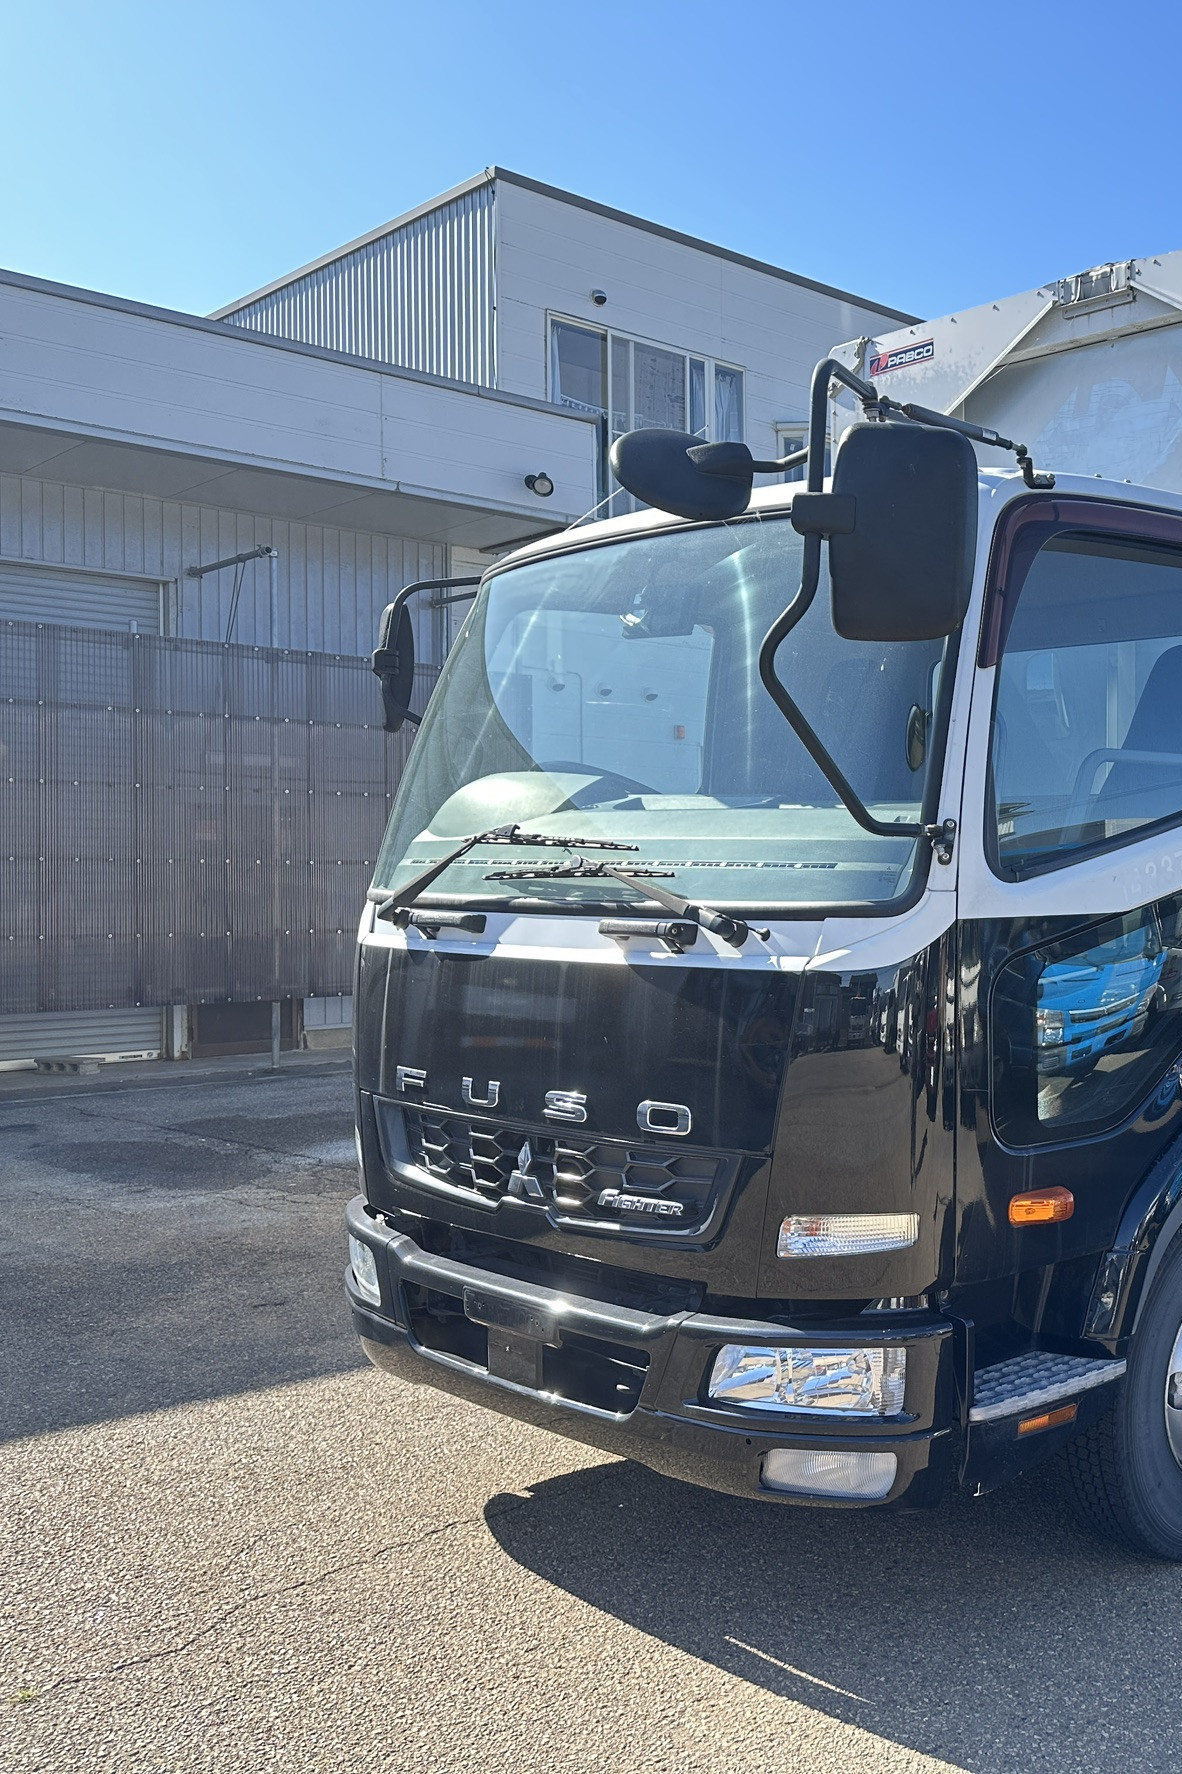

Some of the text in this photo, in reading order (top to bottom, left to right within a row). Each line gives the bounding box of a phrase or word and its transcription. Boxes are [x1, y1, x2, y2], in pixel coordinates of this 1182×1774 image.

[887, 344, 933, 368] PABCO
[396, 1065, 692, 1136] FUSO
[597, 1188, 684, 1216] FIGHTER
